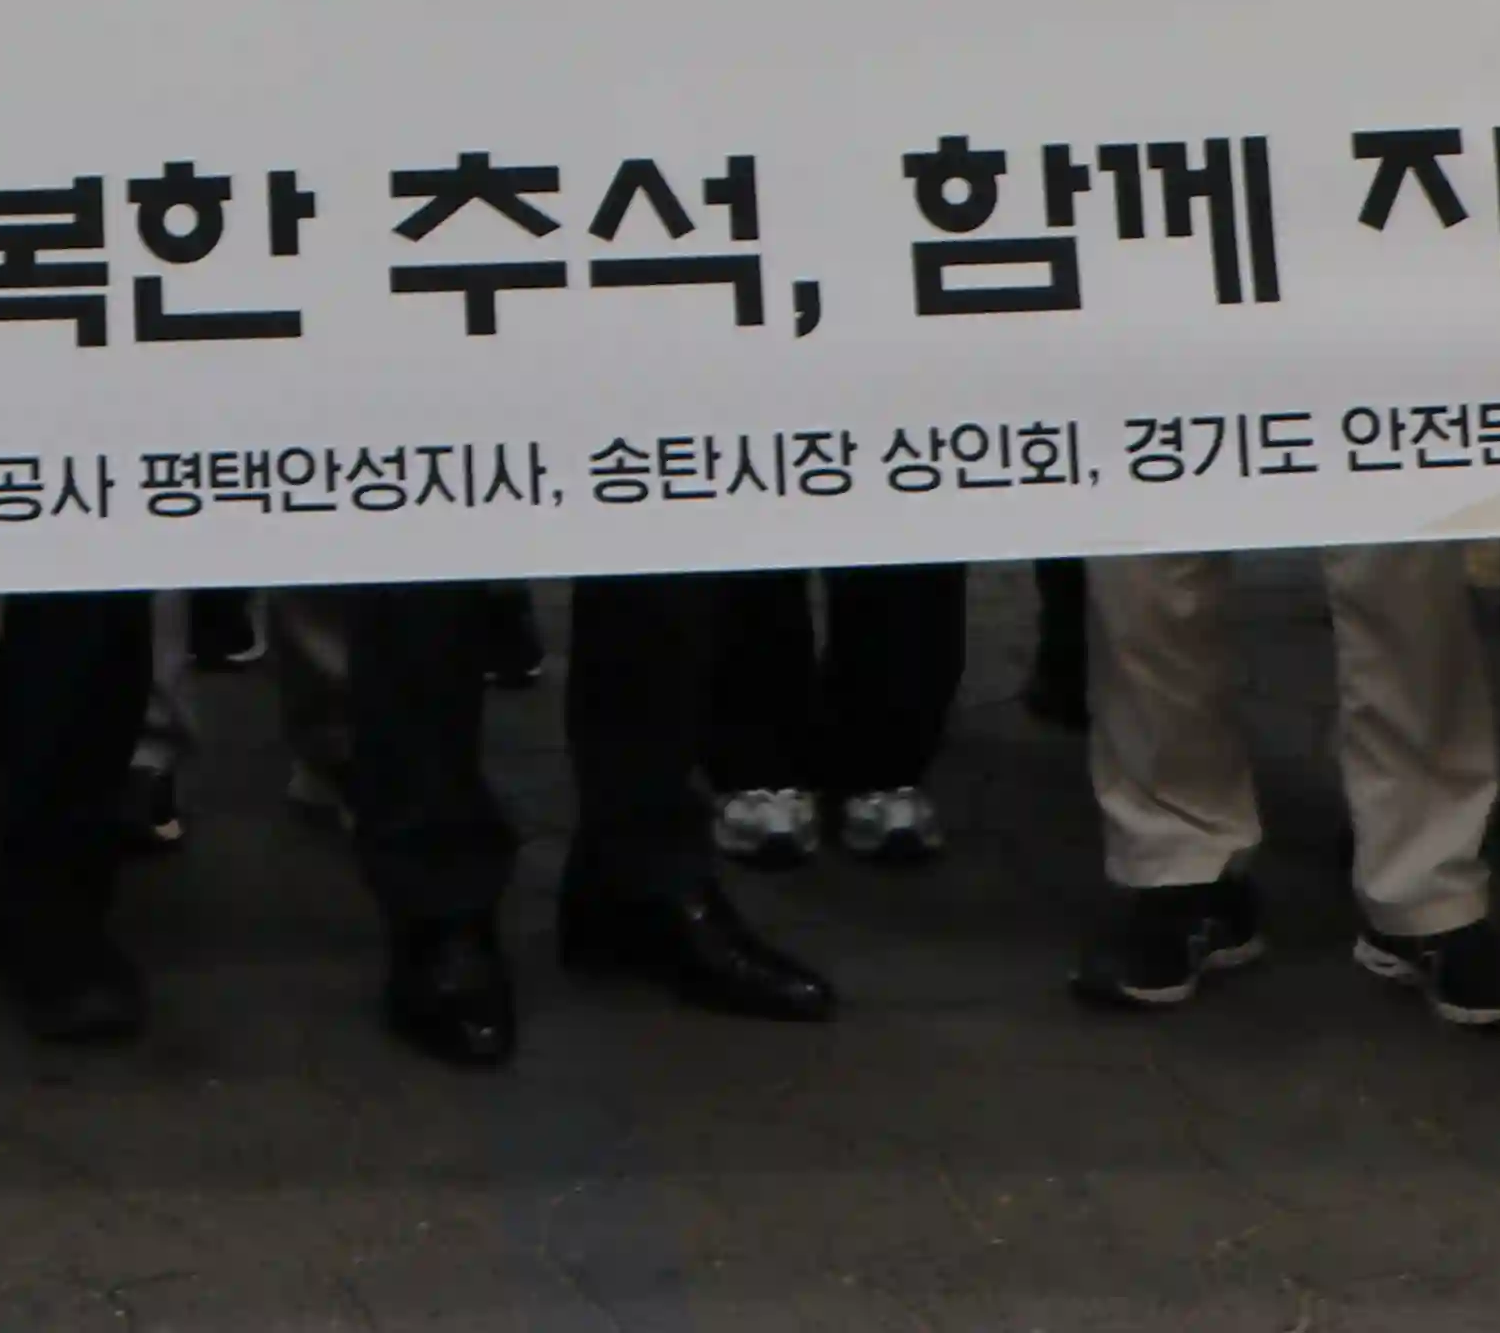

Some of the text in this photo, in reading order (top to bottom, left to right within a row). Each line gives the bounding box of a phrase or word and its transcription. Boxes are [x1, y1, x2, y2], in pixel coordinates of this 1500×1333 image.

[389, 151, 822, 339] 추석,
[902, 134, 1282, 318] 함께
[139, 439, 564, 519] 평택안성지사,
[589, 430, 859, 505] 송탄시장
[881, 421, 1100, 494] 상인회,
[1123, 411, 1319, 484] 경기도
